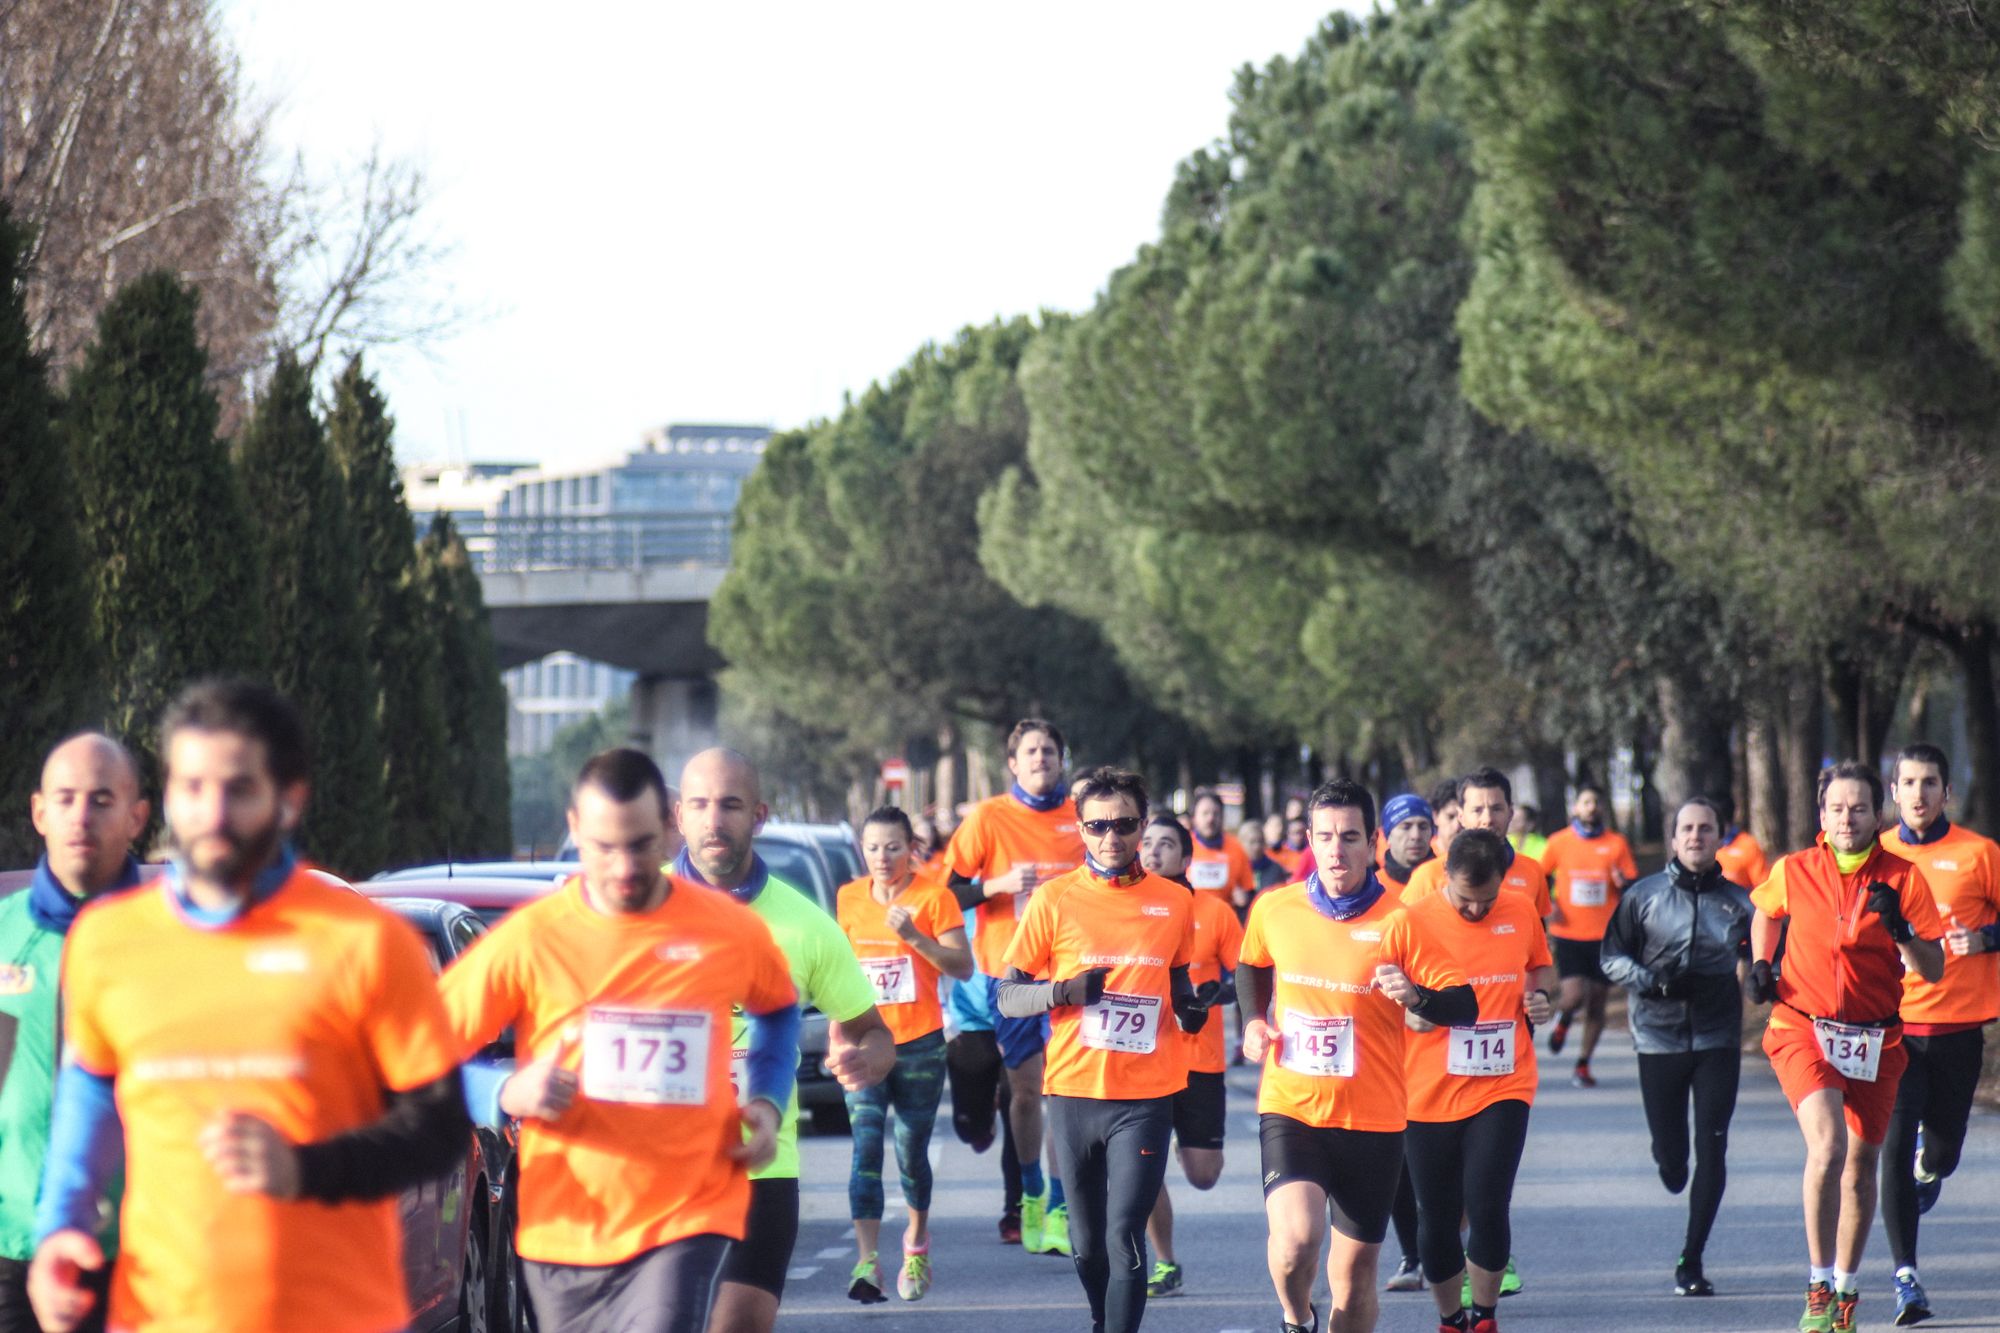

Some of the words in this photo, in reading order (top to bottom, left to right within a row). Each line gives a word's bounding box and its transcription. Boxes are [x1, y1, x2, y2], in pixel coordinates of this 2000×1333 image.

[1124, 954, 1137, 966] by
[1138, 956, 1165, 967] RICOH
[1324, 978, 1339, 992] by
[1340, 982, 1372, 995] RICOH
[1098, 1009, 1146, 1034] 179
[612, 1037, 688, 1075] 173
[1293, 1031, 1338, 1058] 145
[1463, 1038, 1506, 1060] 114
[1826, 1038, 1868, 1062] 134
